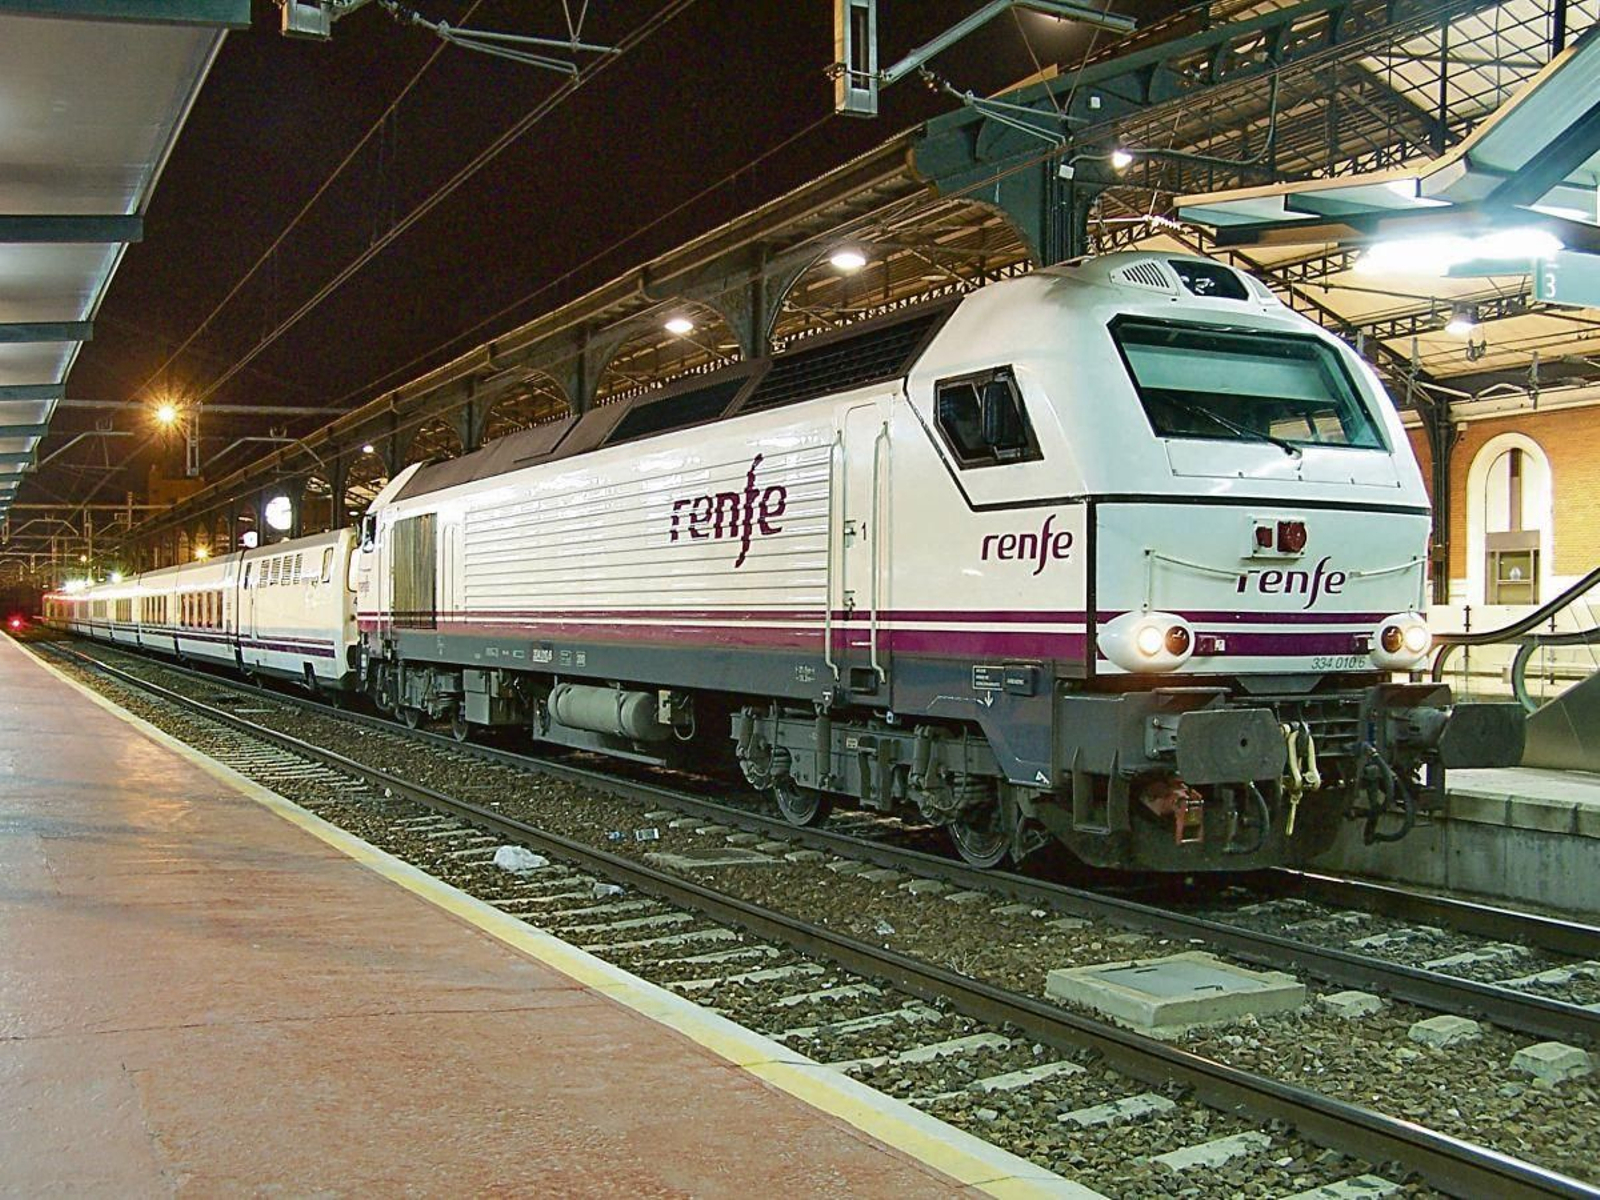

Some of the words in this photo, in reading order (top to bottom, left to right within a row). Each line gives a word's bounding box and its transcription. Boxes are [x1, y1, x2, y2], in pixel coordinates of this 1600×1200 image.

[1545, 273, 1556, 298] 3
[670, 453, 787, 568] renfe
[861, 521, 866, 541] 1
[981, 513, 1073, 576] renfe
[1236, 556, 1346, 610] renfe
